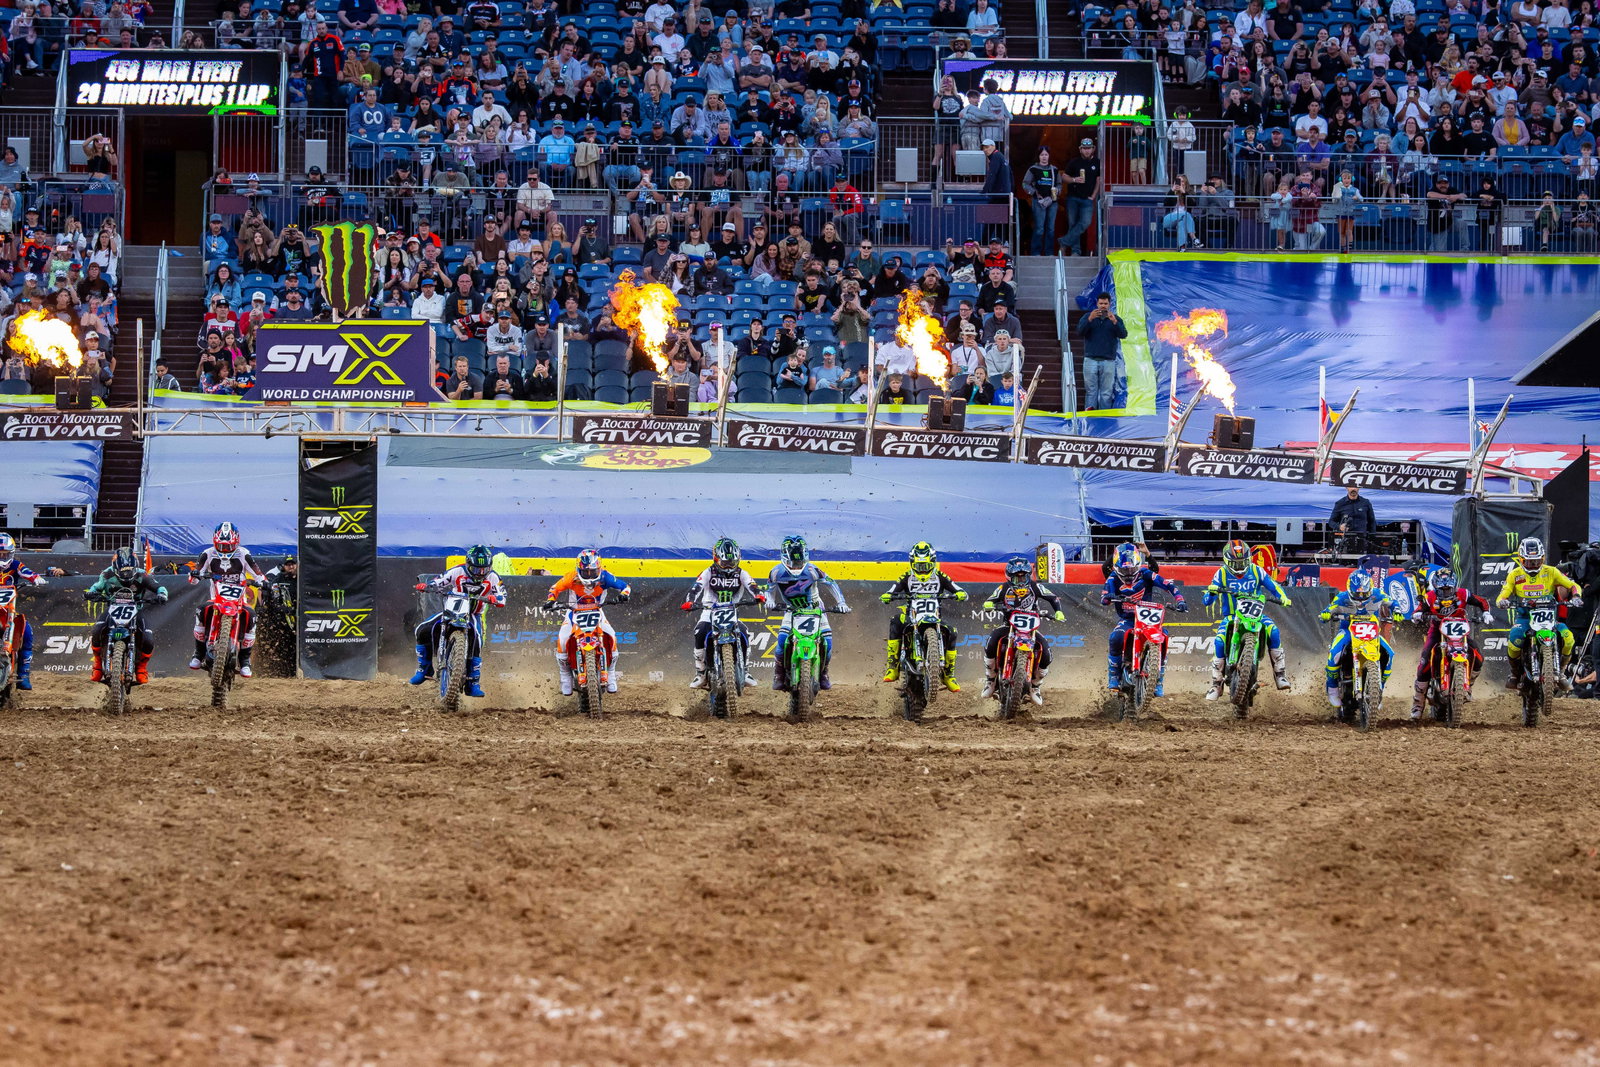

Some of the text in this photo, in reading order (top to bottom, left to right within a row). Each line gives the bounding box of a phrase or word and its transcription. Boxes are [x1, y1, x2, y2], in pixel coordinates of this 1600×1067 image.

[141, 61, 191, 82] MAIN
[191, 61, 243, 82] EVENT
[1015, 70, 1065, 91] MAIN
[1065, 71, 1118, 92] EVENT
[236, 85, 270, 105] LAP
[1109, 95, 1144, 115] LAP
[364, 111, 383, 125] CO
[261, 333, 413, 385] SMX
[262, 389, 414, 400] WORLD CHAMPIONSHIP
[22, 414, 123, 424] ROCKY MOUNTAIN
[600, 418, 701, 431] ROCKY MOUNTAIN
[757, 423, 857, 440] ROCKY MOUNTAIN
[901, 431, 1000, 446] ROCKY MOUNTAIN
[1055, 440, 1157, 456] ROCKY MOUNTAIN
[1206, 451, 1306, 467] ROCKY MOUNTAIN
[1360, 461, 1397, 474] ROCKY
[1397, 464, 1458, 478] MOUNTAIN
[304, 510, 369, 533] SMX
[1480, 562, 1515, 574] SM
[220, 586, 242, 598] 28
[911, 583, 938, 591] FXR
[111, 605, 134, 620] 46
[452, 600, 462, 611] 1
[916, 601, 936, 613] 20
[1239, 601, 1263, 616] 36
[576, 613, 600, 628] 26
[713, 609, 735, 625] 32
[1013, 616, 1036, 629] 51
[1139, 609, 1161, 623] 96
[1531, 611, 1554, 623] 784
[304, 614, 369, 637] SMX
[797, 617, 815, 633] 4
[1355, 623, 1377, 637] 94
[1445, 623, 1466, 636] 14
[44, 664, 74, 672] WORLD
